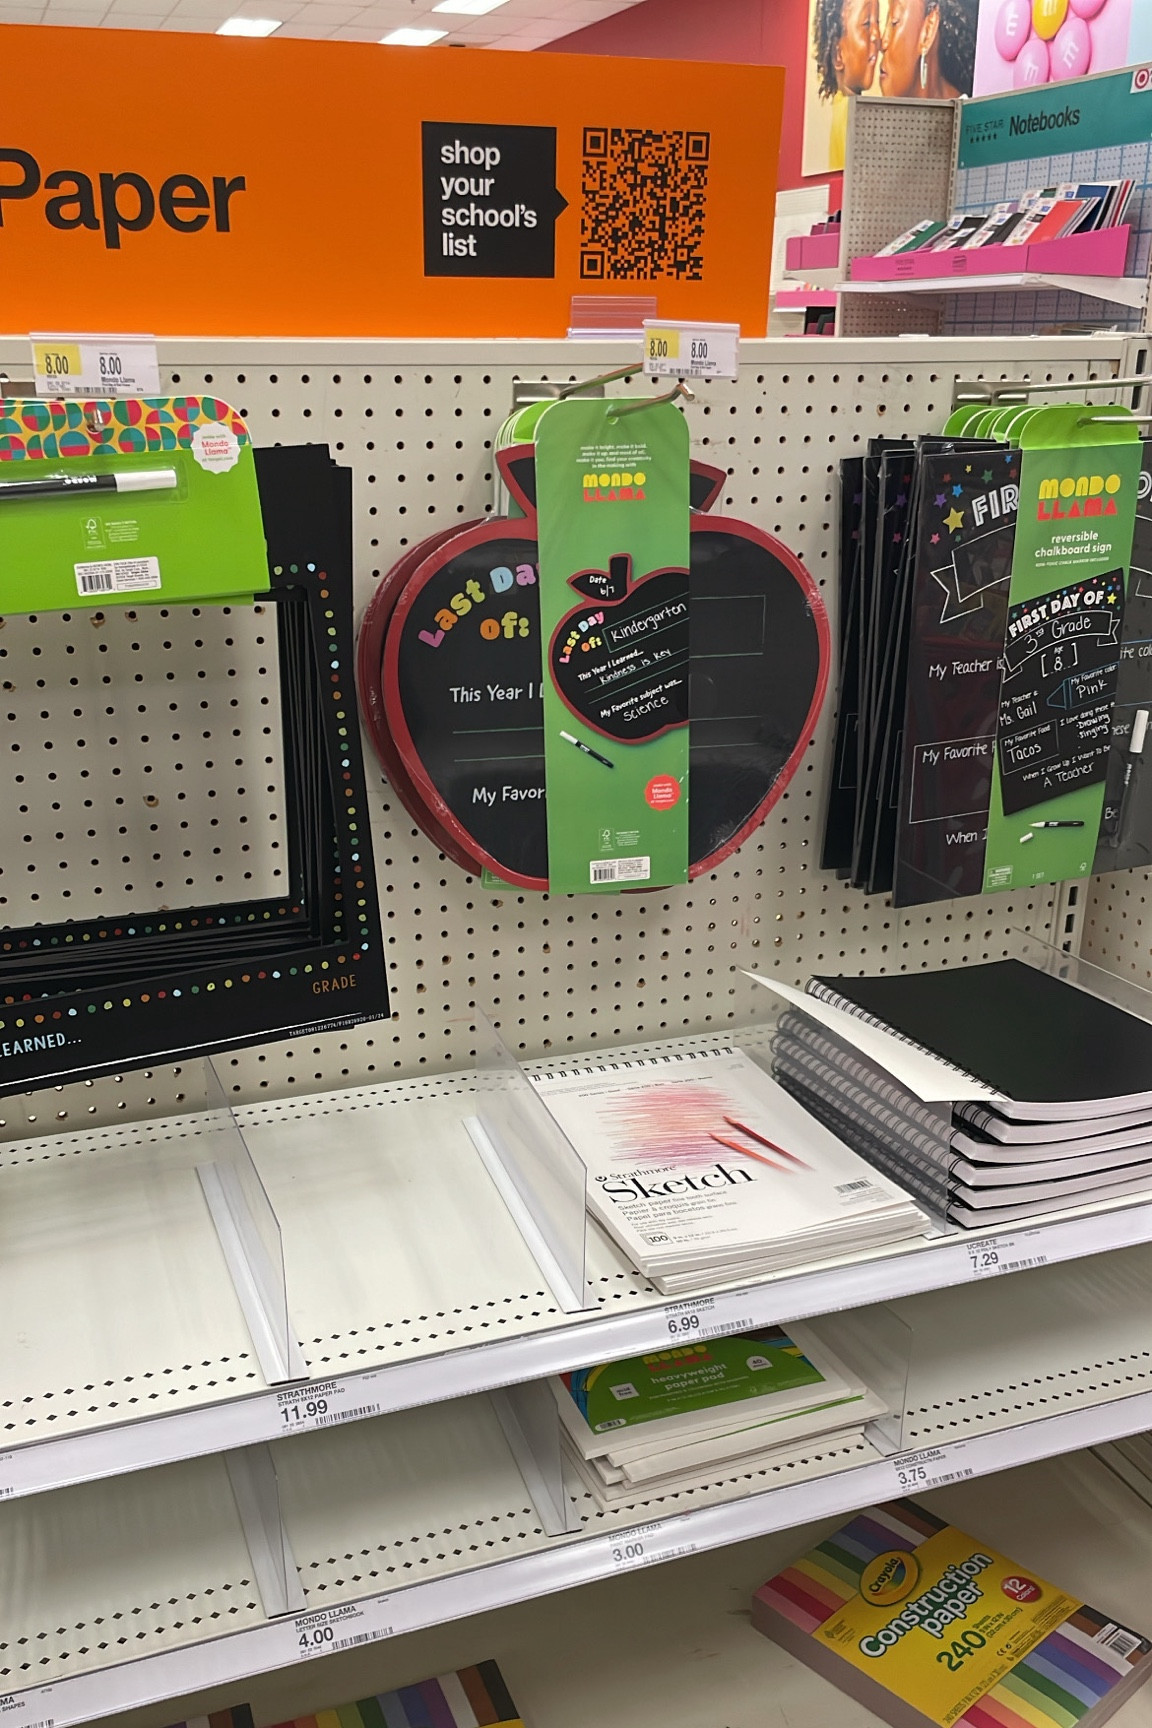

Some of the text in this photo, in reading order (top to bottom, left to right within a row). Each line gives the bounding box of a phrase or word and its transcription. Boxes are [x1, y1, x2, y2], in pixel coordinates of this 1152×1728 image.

[1009, 106, 1080, 137] Notebooks
[441, 139, 500, 171] shop
[0, 147, 246, 249] Paper
[440, 177, 495, 200] your
[441, 203, 537, 228] school's
[442, 232, 477, 256] list
[649, 340, 668, 357] 8.00
[691, 342, 708, 359] 8.00
[45, 356, 69, 375] 8.00
[99, 356, 121, 375] 8.00
[201, 440, 229, 448] Mondo
[583, 472, 646, 488] MONDO
[1038, 474, 1121, 500] MONDO
[583, 487, 646, 503] LLAMA
[1037, 497, 1118, 522] LLAMA
[1051, 530, 1099, 544] reversible
[1035, 542, 1112, 558] chalkboard sign
[589, 575, 607, 584] Date
[418, 563, 540, 648] Last Da
[1008, 590, 1104, 638] FIRST DAY OF
[578, 611, 605, 632] Day
[611, 602, 687, 642] Kindergarten
[1051, 615, 1092, 639] Grade
[578, 671, 591, 682] This
[591, 664, 607, 675] Year
[600, 664, 636, 685] Kindness
[641, 658, 651, 667] is
[929, 664, 947, 681] My
[952, 660, 992, 676] Teacher
[1054, 656, 1063, 671] 8
[449, 682, 534, 703] This Year I
[1076, 679, 1108, 698] Pink
[600, 709, 611, 719] My
[611, 697, 639, 712] Favorite
[623, 695, 669, 721] Science
[1016, 701, 1037, 720] Gail
[922, 742, 988, 765] My Favorite
[1007, 743, 1042, 763] Tacos
[1043, 762, 1094, 788] A Teacher
[472, 786, 497, 807] My
[946, 832, 977, 845] When
[312, 974, 357, 994] GRADE
[0, 1033, 81, 1057] EARNED...
[609, 1165, 674, 1180] Strathmore
[602, 1163, 758, 1204] Sketch
[618, 1202, 647, 1211] Sketch
[648, 1198, 671, 1208] paper
[622, 1208, 649, 1216] Papier
[659, 1202, 690, 1211] croquis
[627, 1213, 651, 1222] Papel
[653, 1211, 672, 1219] para
[674, 1206, 705, 1214] bocetos
[649, 1234, 669, 1242] 100
[967, 1239, 997, 1250] UCREATE
[970, 1252, 999, 1268] 7.29
[664, 1297, 715, 1314] STRATHMORE
[668, 1315, 699, 1333] 6.99
[643, 1345, 707, 1364] MONDO
[651, 1364, 727, 1384] heavyweight
[665, 1378, 699, 1391] paper
[702, 1372, 725, 1383] pad
[277, 1381, 337, 1401] STRATHMORE
[278, 1399, 300, 1407] STRATH
[315, 1390, 332, 1399] PAPER
[281, 1399, 328, 1422] 11.99
[894, 1449, 941, 1466] MONDO LLAMA
[898, 1467, 927, 1484] 3.75
[608, 1529, 637, 1541] MONDO
[638, 1523, 662, 1535] LLAMA
[613, 1543, 644, 1562] 3.00
[869, 1557, 899, 1593] Crayola
[1004, 1578, 1026, 1593] 12
[860, 1553, 993, 1657] Construction
[921, 1582, 983, 1639] paper
[295, 1605, 356, 1628] MONDO LLAMA
[296, 1611, 364, 1633] LETTER SIZE SKETCHBOOK
[299, 1627, 333, 1647] 4.00
[936, 1630, 987, 1671] 240
[2, 1701, 25, 1711] SHAPES
